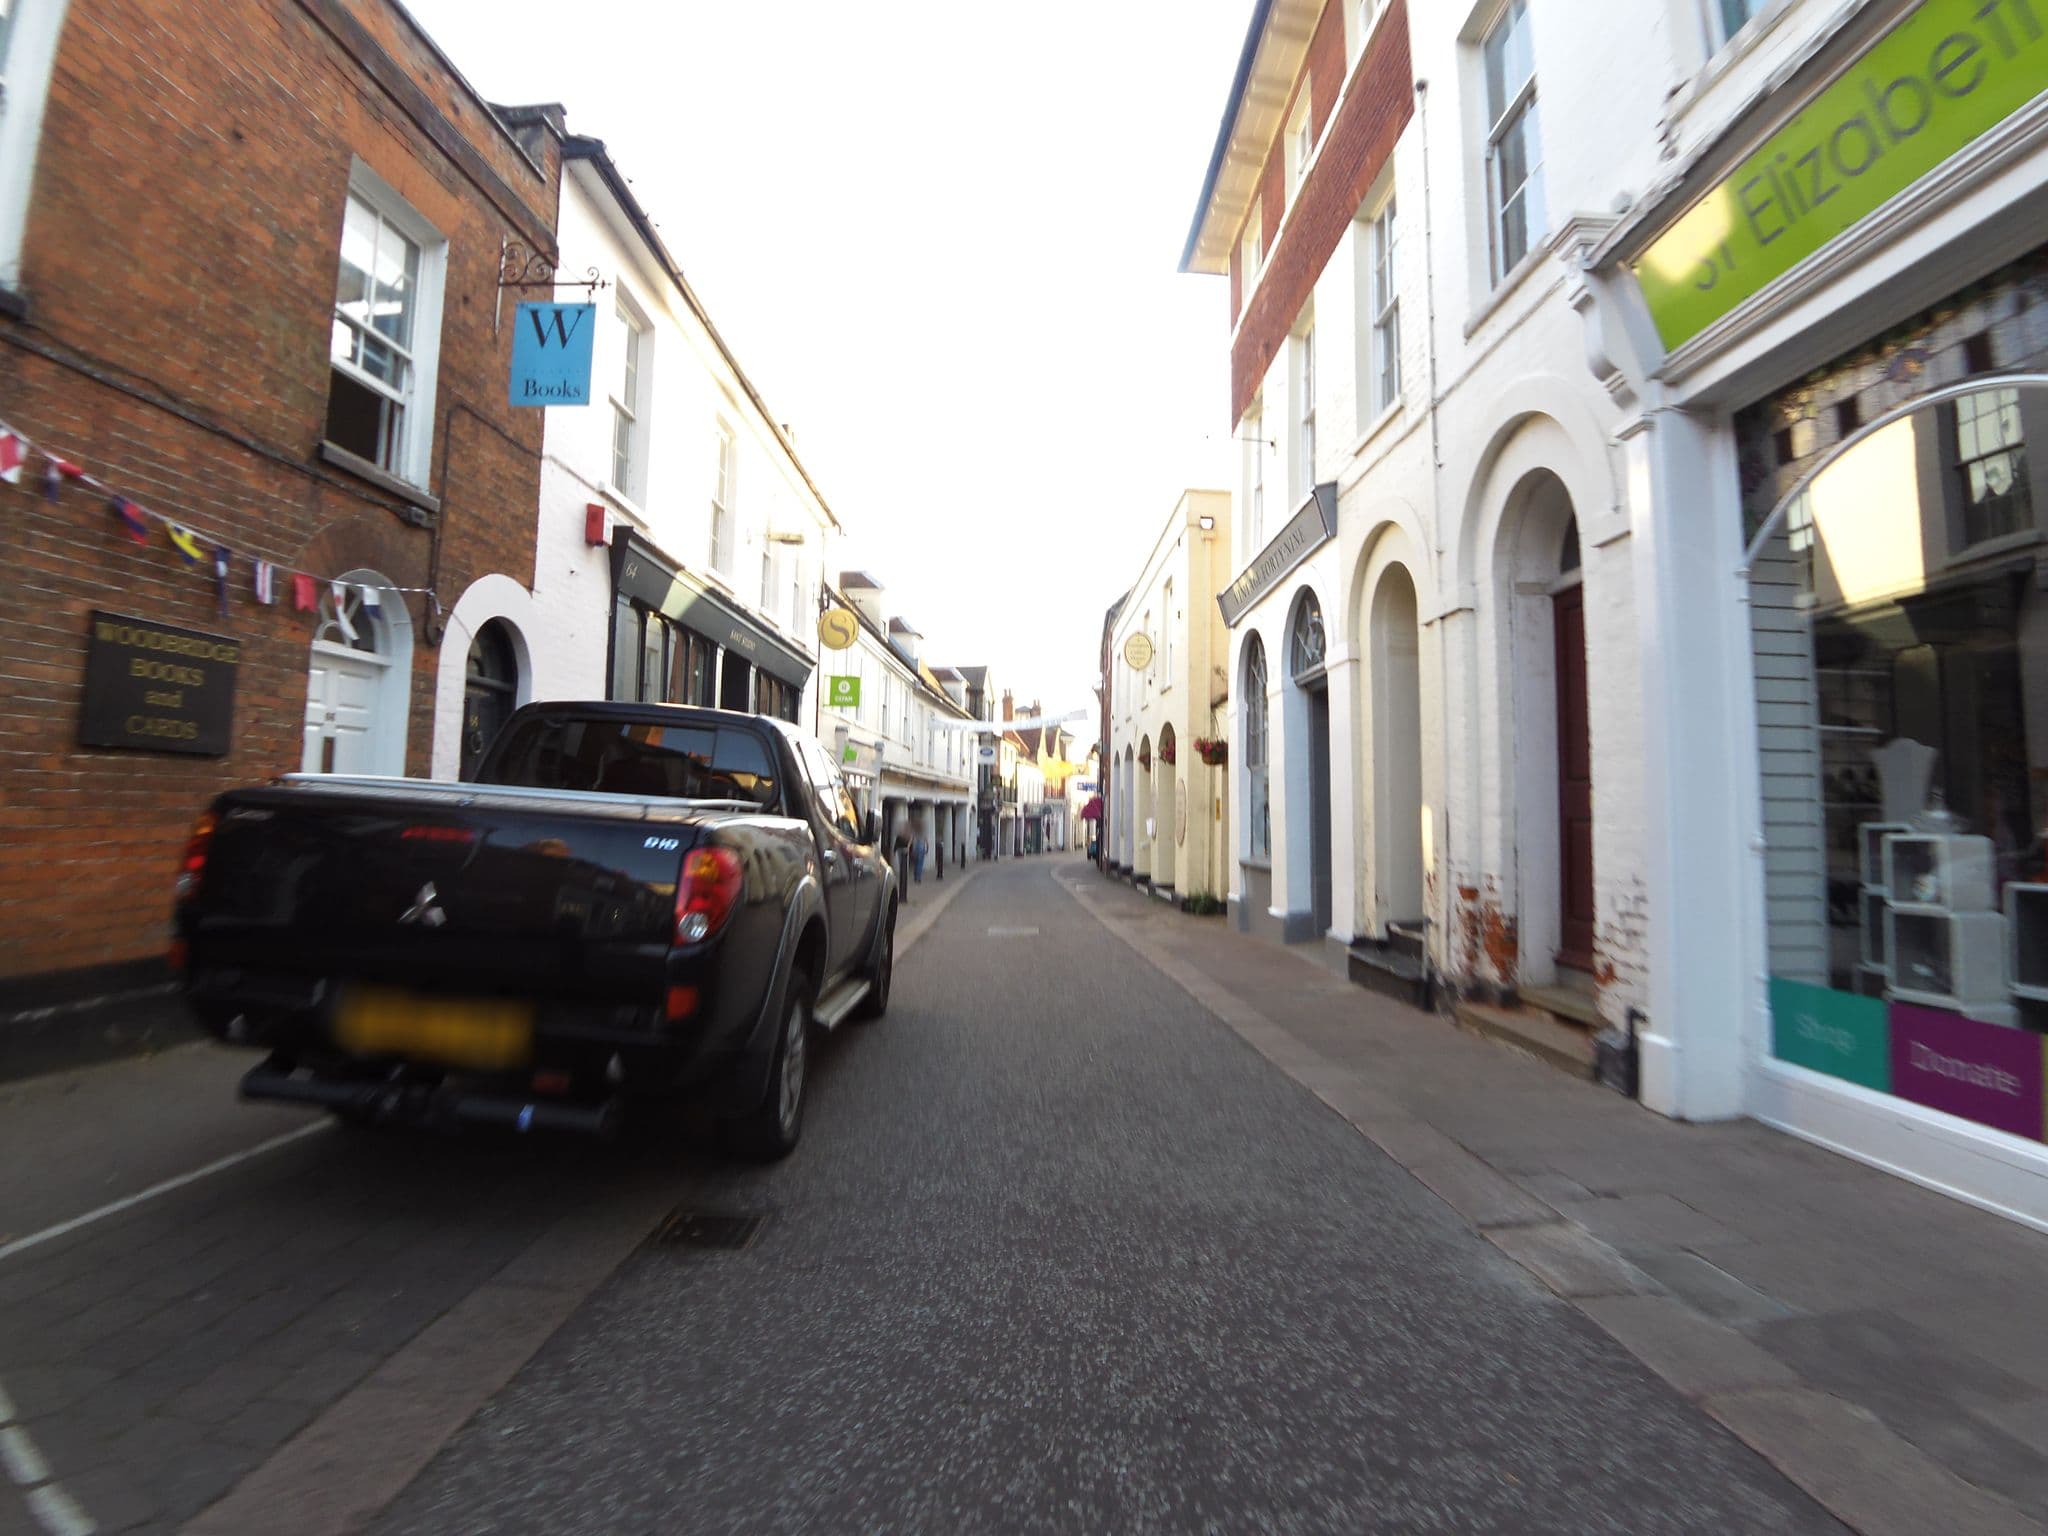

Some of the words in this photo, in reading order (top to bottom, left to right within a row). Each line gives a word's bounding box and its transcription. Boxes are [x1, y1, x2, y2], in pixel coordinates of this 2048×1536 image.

[529, 308, 585, 349] W
[523, 378, 581, 398] Books
[625, 563, 639, 580] 64
[95, 621, 240, 664] WOODBRIDGE
[129, 658, 206, 686] BOOKS
[144, 690, 184, 708] and
[126, 714, 199, 740] CARDS
[1909, 1039, 2022, 1097] Donate
